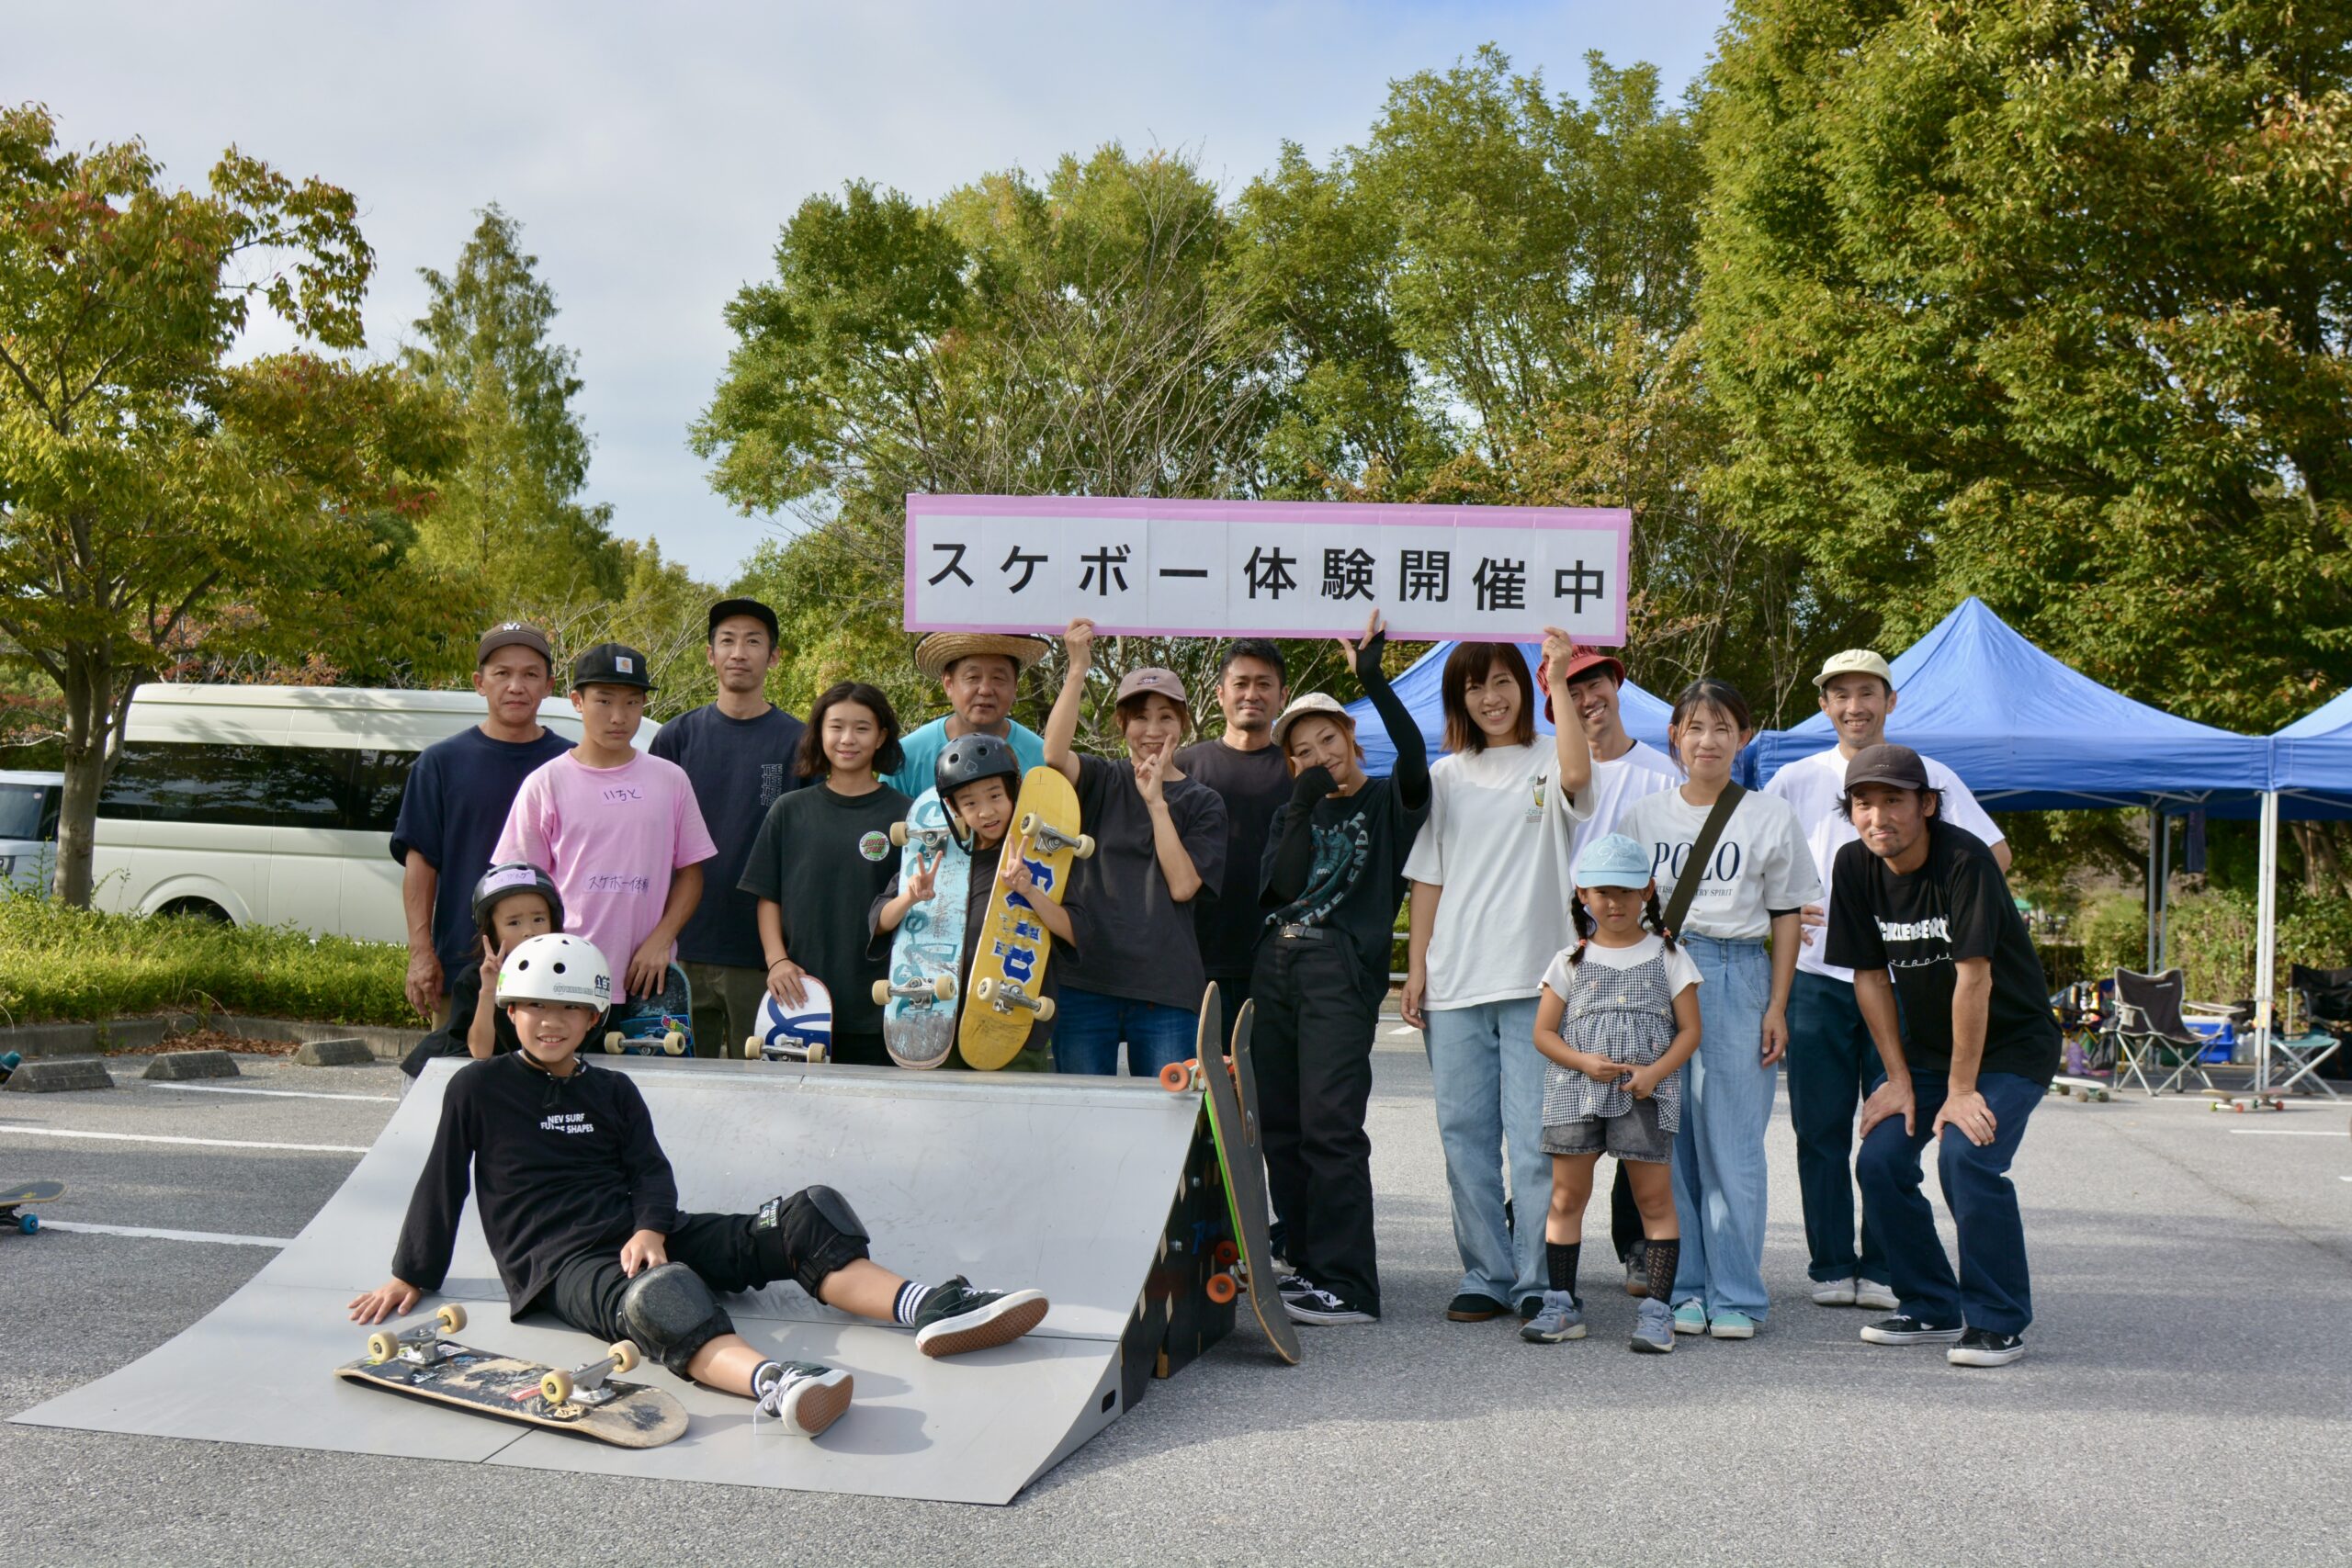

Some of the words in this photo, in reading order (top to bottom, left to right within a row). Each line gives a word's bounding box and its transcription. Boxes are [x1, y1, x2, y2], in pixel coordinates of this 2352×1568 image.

[927, 542, 1605, 614] スケボー体験開催中
[1650, 841, 1740, 882] POO
[565, 1112, 585, 1122] SURF
[566, 1123, 594, 1134] SHAPES
